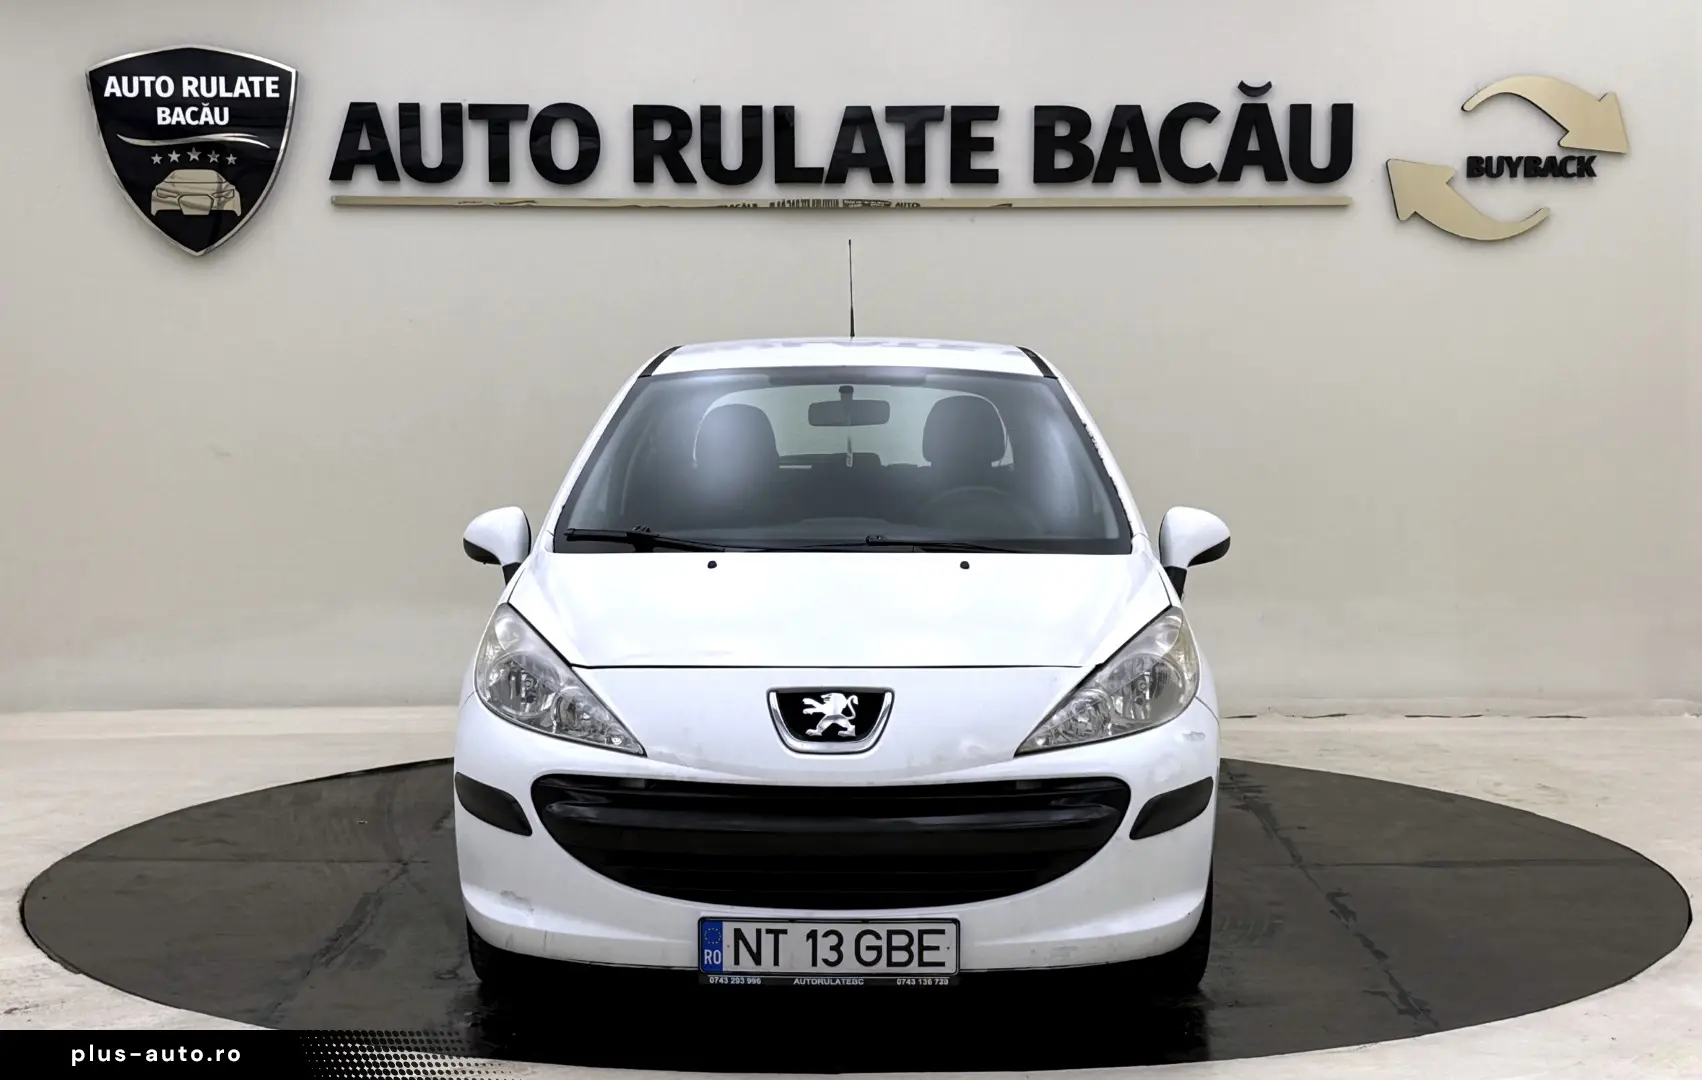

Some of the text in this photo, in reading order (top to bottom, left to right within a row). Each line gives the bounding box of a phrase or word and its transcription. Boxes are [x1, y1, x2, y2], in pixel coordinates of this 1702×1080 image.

[104, 76, 280, 98] AUTO RULATE
[156, 102, 229, 126] BACĂU
[329, 80, 1354, 185] AUTO RULATE BACĂU
[1466, 155, 1597, 178] BUYBACK
[704, 949, 722, 965] RO
[733, 928, 946, 968] NT 13 GBE
[709, 976, 729, 985] 0743
[896, 978, 916, 986] 0743
